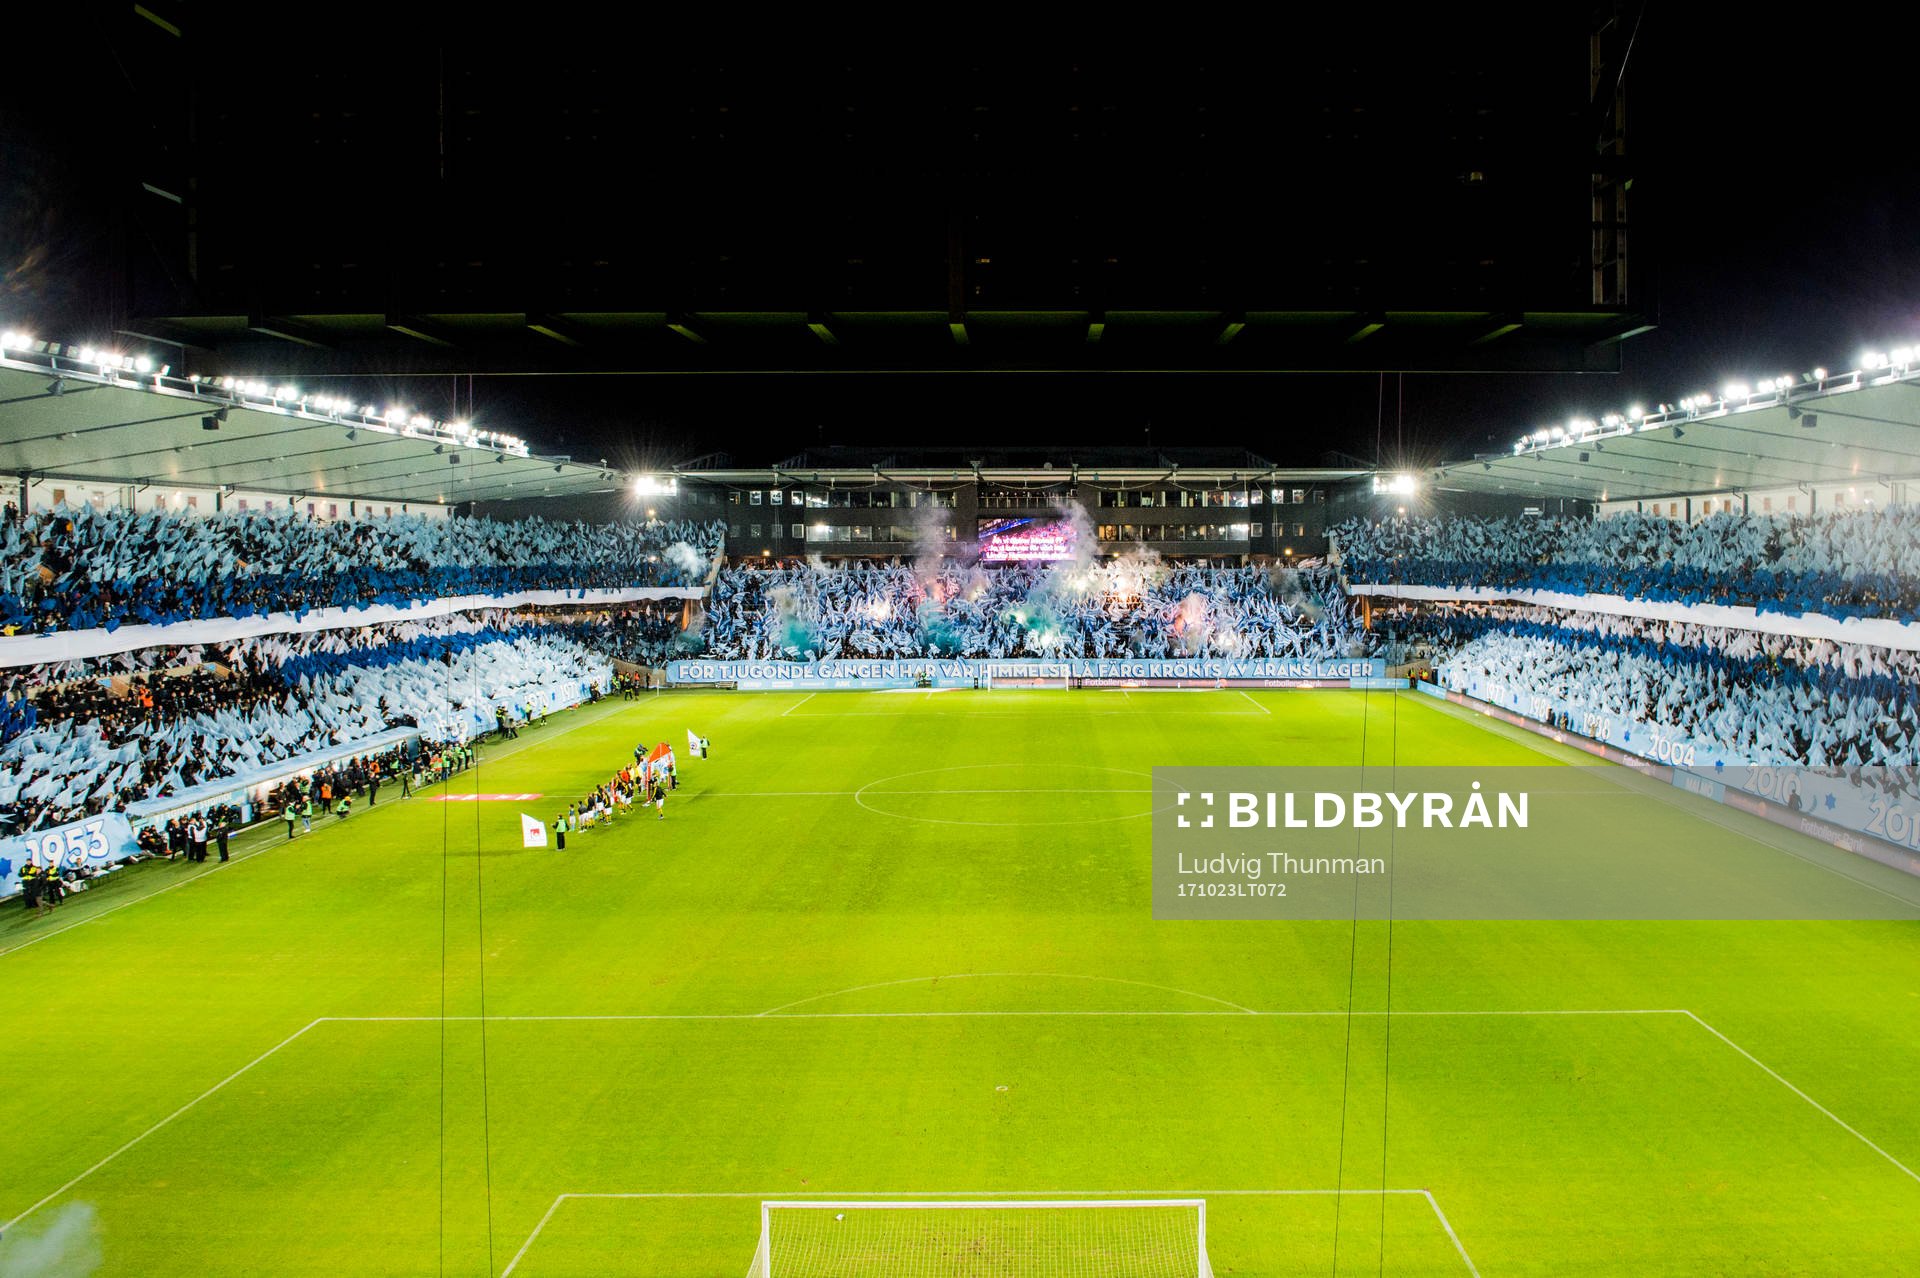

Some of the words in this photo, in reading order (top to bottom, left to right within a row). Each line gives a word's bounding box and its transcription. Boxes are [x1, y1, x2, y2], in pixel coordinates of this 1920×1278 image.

[679, 662, 714, 679] FÖR
[719, 664, 814, 679] TJUGONDE
[818, 662, 895, 679] GÅNGEN
[900, 664, 936, 678] HAR
[941, 661, 974, 678] VÅR
[1100, 661, 1145, 678] FÄRG
[1150, 660, 1222, 678] KRÖNTS
[1227, 664, 1249, 678] AV
[1253, 660, 1312, 678] ÄRANS
[1317, 664, 1373, 677] LAGER
[1646, 733, 1696, 768] 2004
[1742, 766, 1801, 806] 2010
[25, 819, 110, 868] 1953
